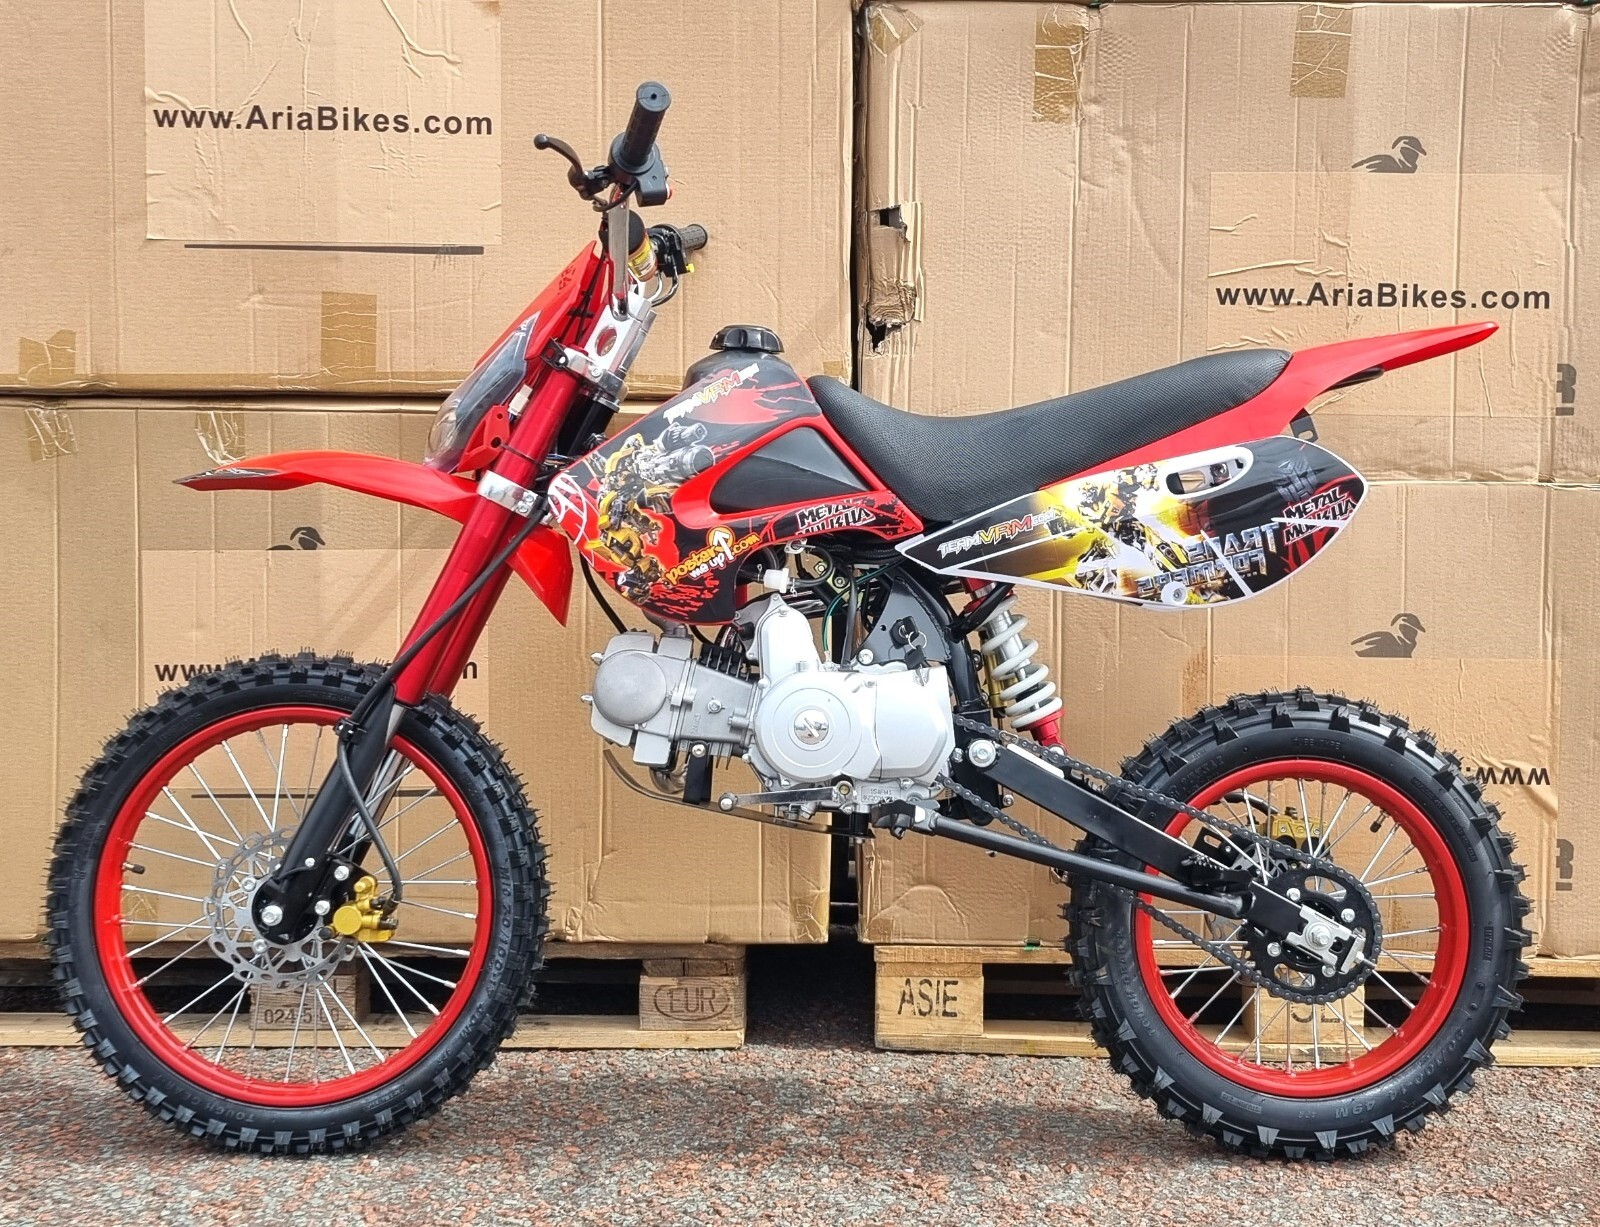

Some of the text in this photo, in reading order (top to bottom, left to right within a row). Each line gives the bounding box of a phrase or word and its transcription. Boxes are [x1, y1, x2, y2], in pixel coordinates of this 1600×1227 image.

[153, 105, 493, 135] www.AriaBikes.com
[1216, 282, 1550, 309] www.AriaBikes.com
[669, 987, 716, 1014] EUR
[897, 978, 959, 1018] ASIE
[205, 1101, 255, 1122] TOUGH
[1336, 1099, 1376, 1118] 49M
